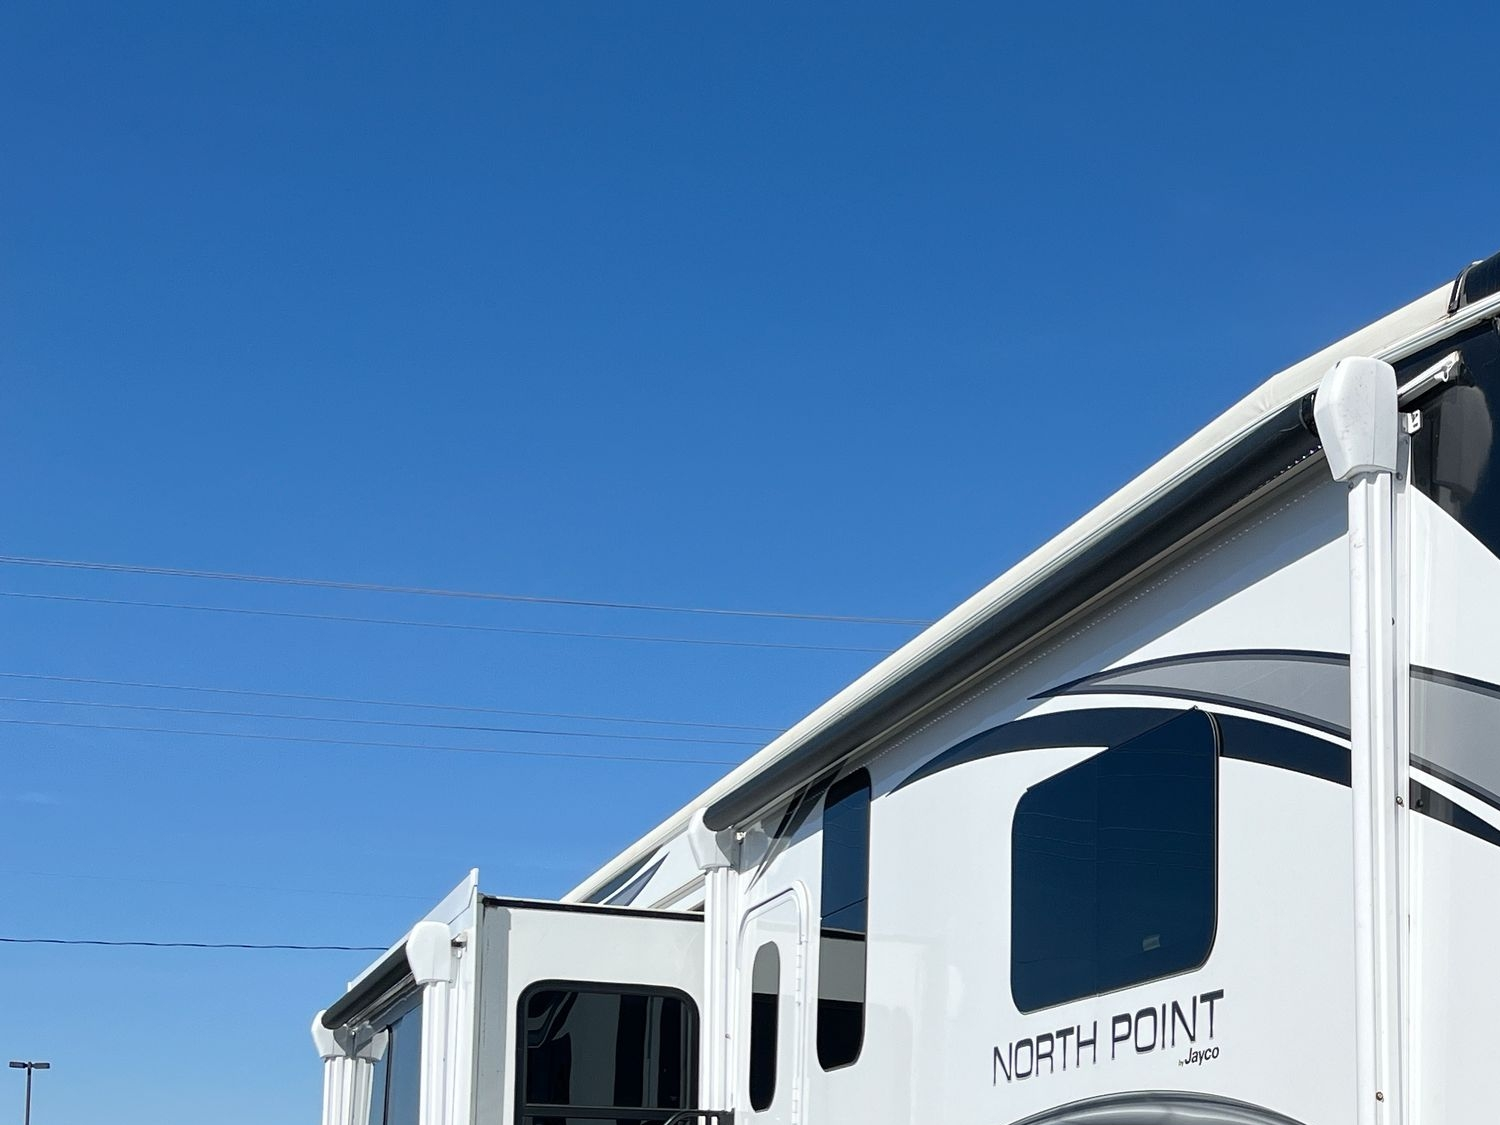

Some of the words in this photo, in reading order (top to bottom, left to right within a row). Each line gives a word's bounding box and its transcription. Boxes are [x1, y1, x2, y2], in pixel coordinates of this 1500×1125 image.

[993, 1020, 1098, 1087] NORTH
[1111, 988, 1225, 1060] POINT
[1184, 1046, 1220, 1066] Jayco
